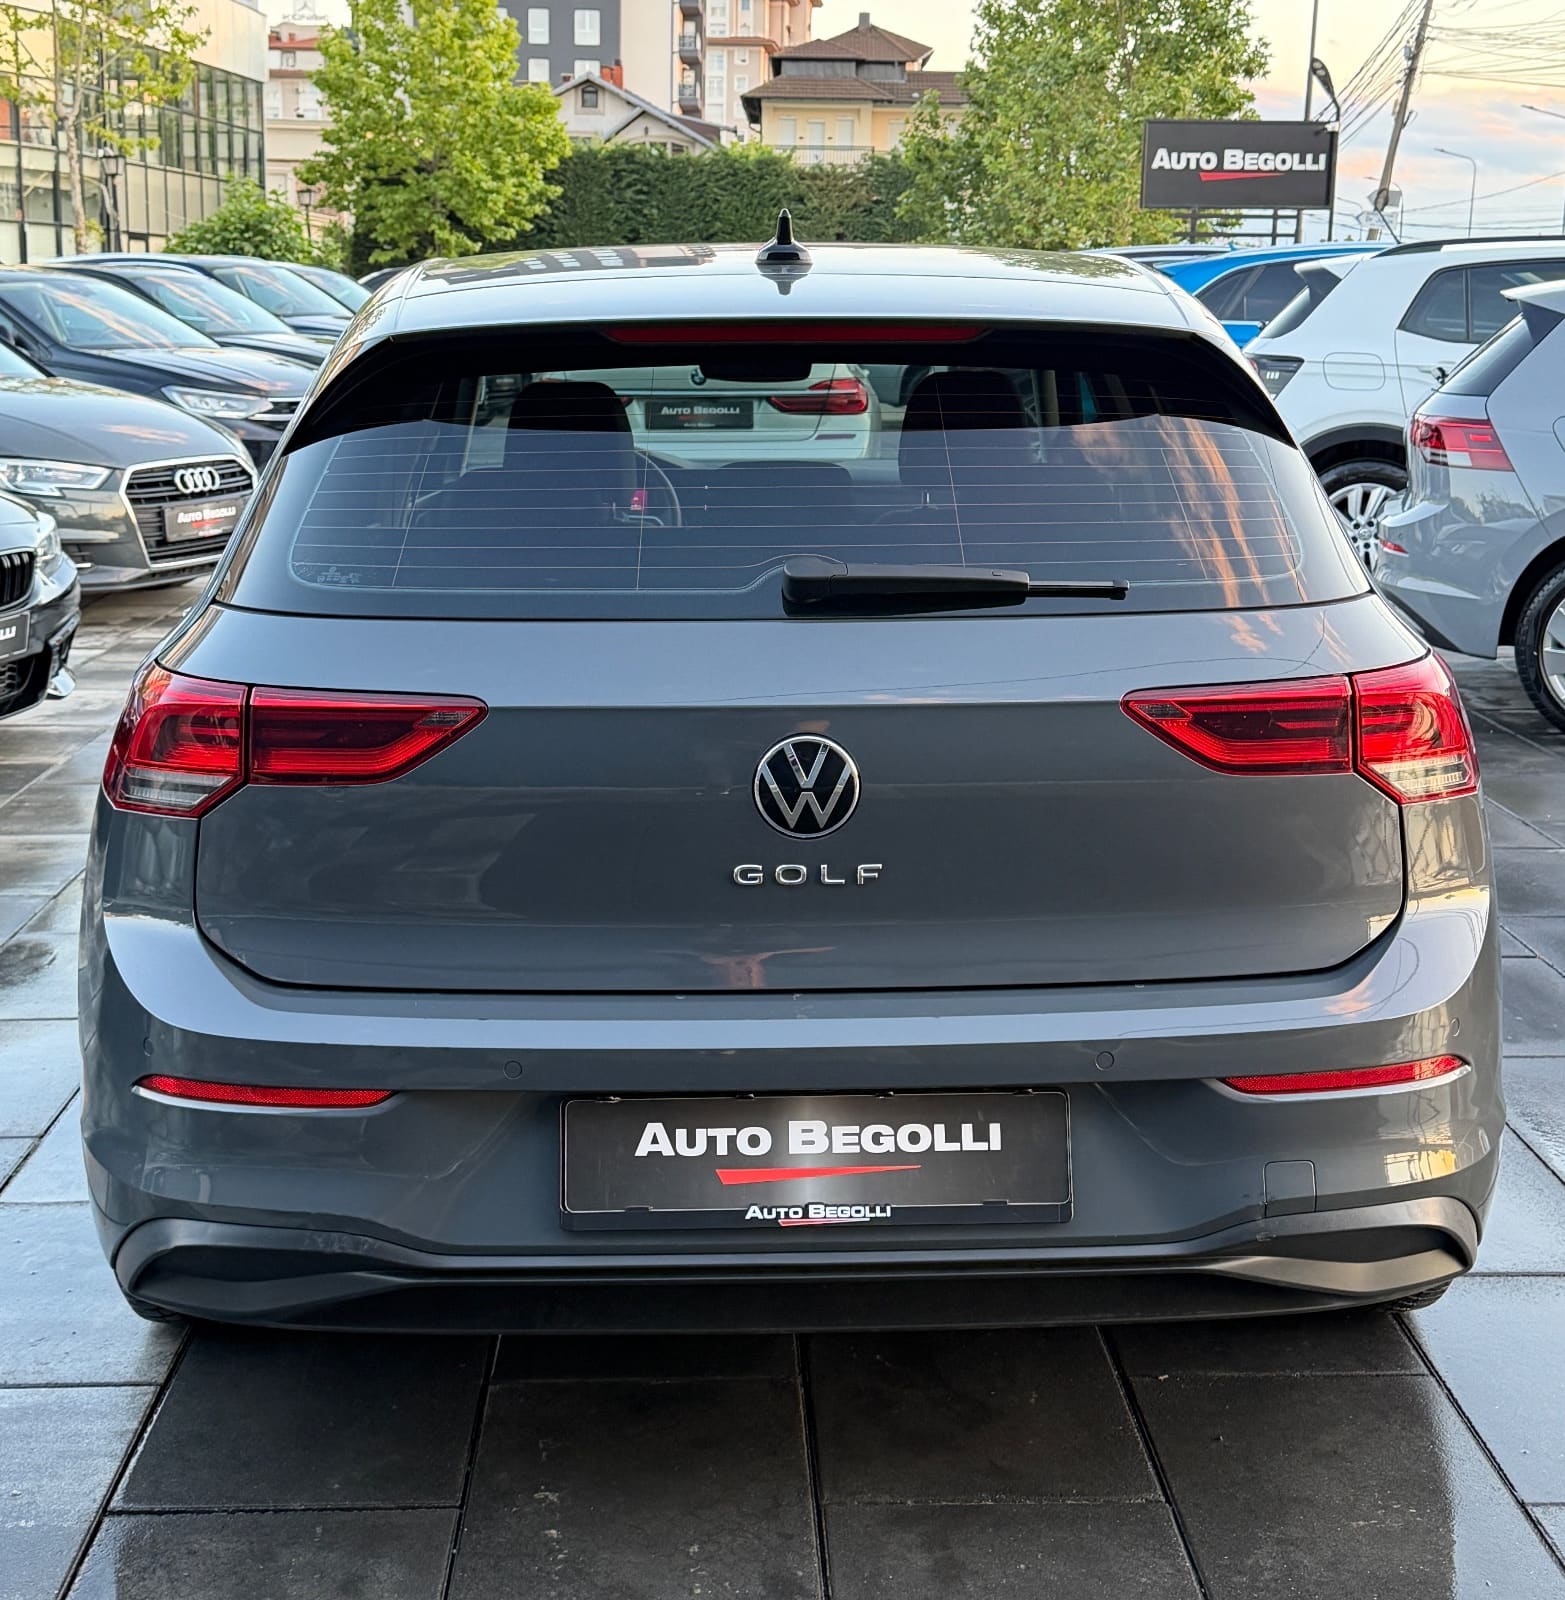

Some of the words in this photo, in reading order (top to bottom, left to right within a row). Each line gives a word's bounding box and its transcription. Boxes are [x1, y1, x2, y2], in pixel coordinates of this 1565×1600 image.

[1151, 148, 1218, 170] AUTO
[1223, 149, 1327, 171] BEGOLLI
[661, 406, 691, 415] AUTO
[733, 864, 882, 885] GOLF
[634, 1122, 772, 1157] AUTO
[788, 1120, 1001, 1155] BEGOLLI
[745, 1205, 803, 1219] AUTO
[808, 1204, 891, 1218] BEGOLLI
